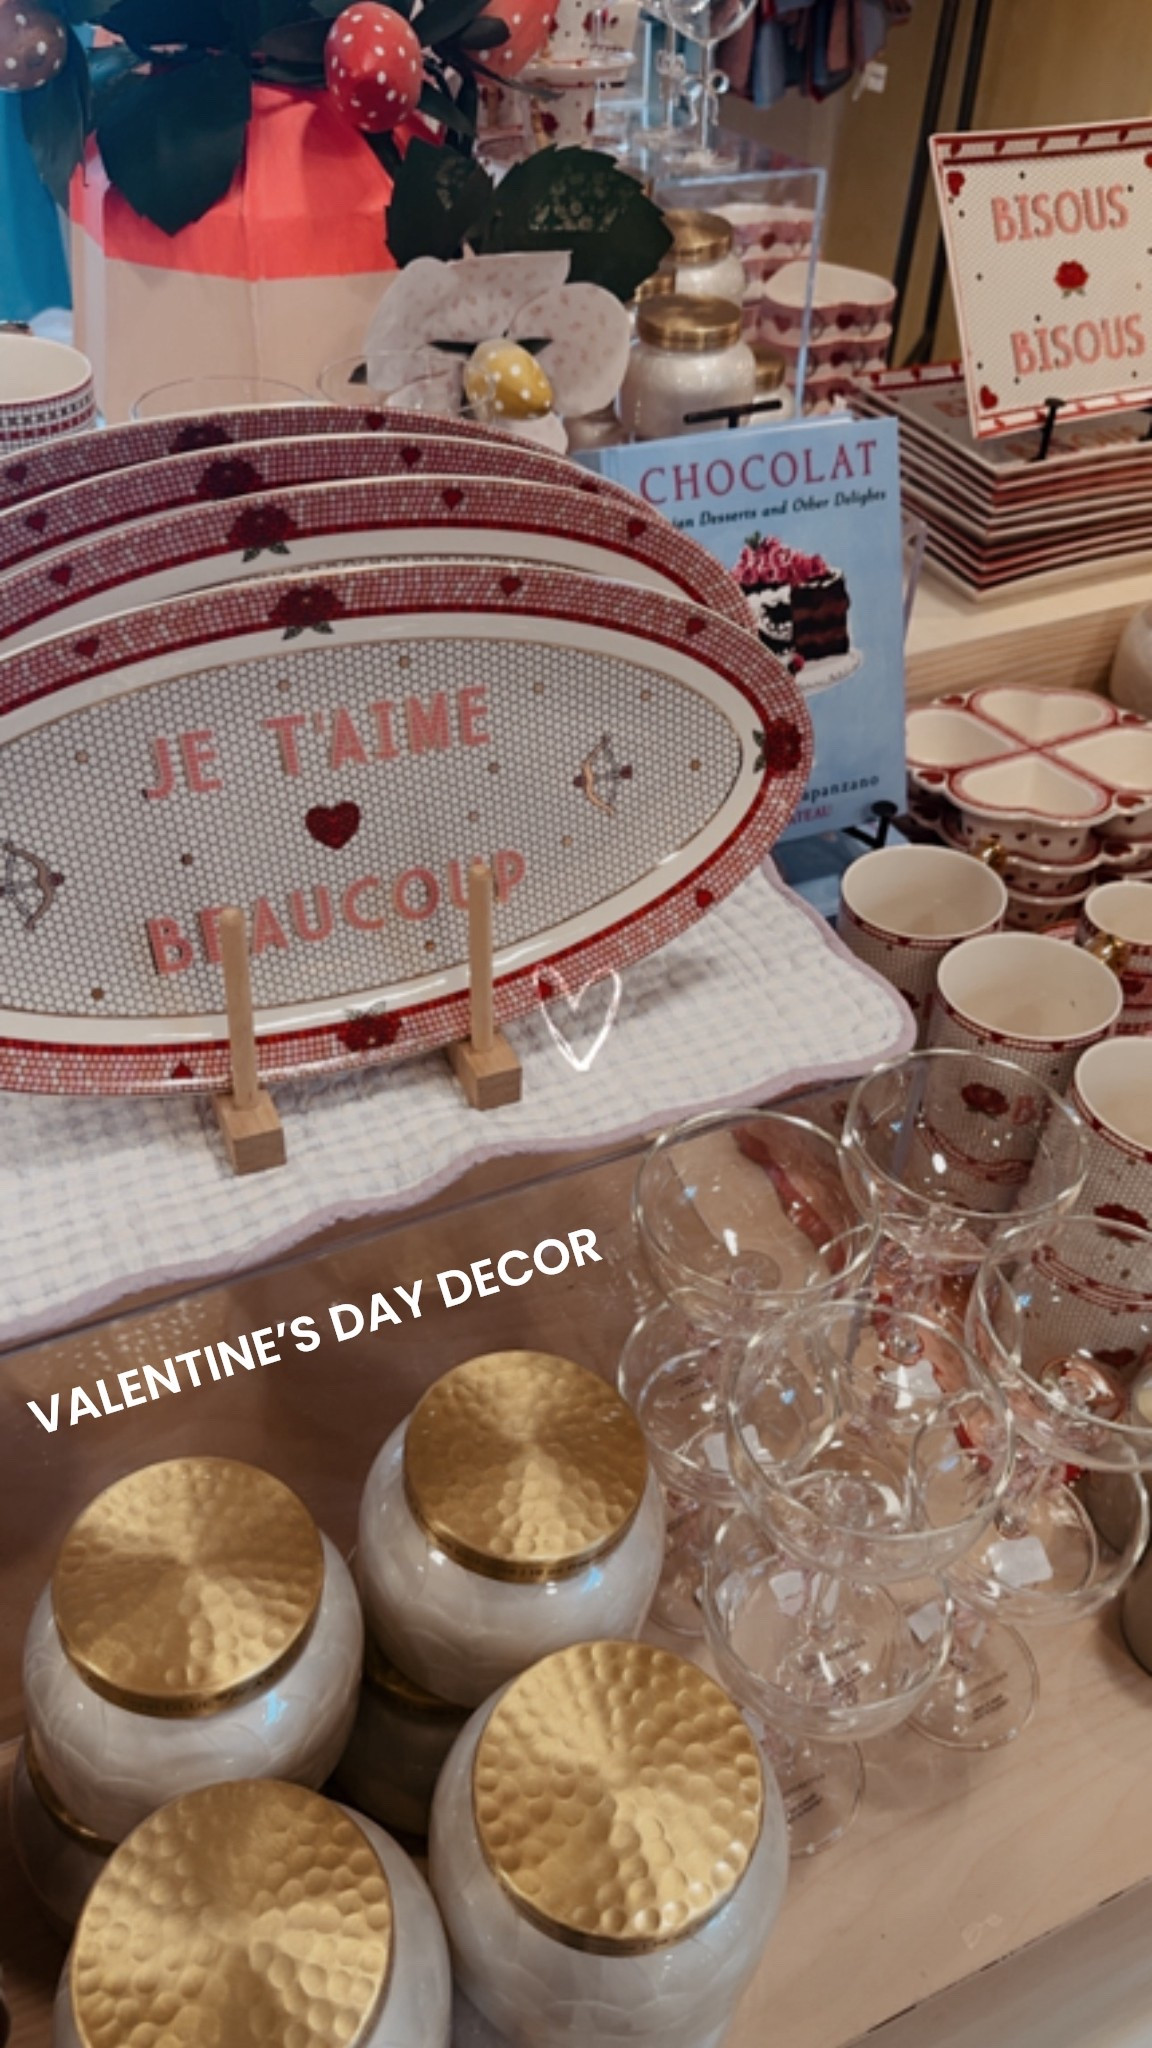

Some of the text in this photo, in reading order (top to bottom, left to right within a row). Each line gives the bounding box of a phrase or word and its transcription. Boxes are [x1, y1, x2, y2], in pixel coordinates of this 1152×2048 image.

[991, 183, 1129, 244] BISOUS
[1010, 313, 1146, 376] BISOUS
[639, 440, 878, 504] CHOCOLAT
[699, 510, 757, 528] Desserts
[762, 499, 788, 518] and
[793, 496, 829, 513] Other
[834, 487, 886, 508] Delights
[145, 685, 491, 799] JE T'AIME
[802, 775, 880, 804] apanzano
